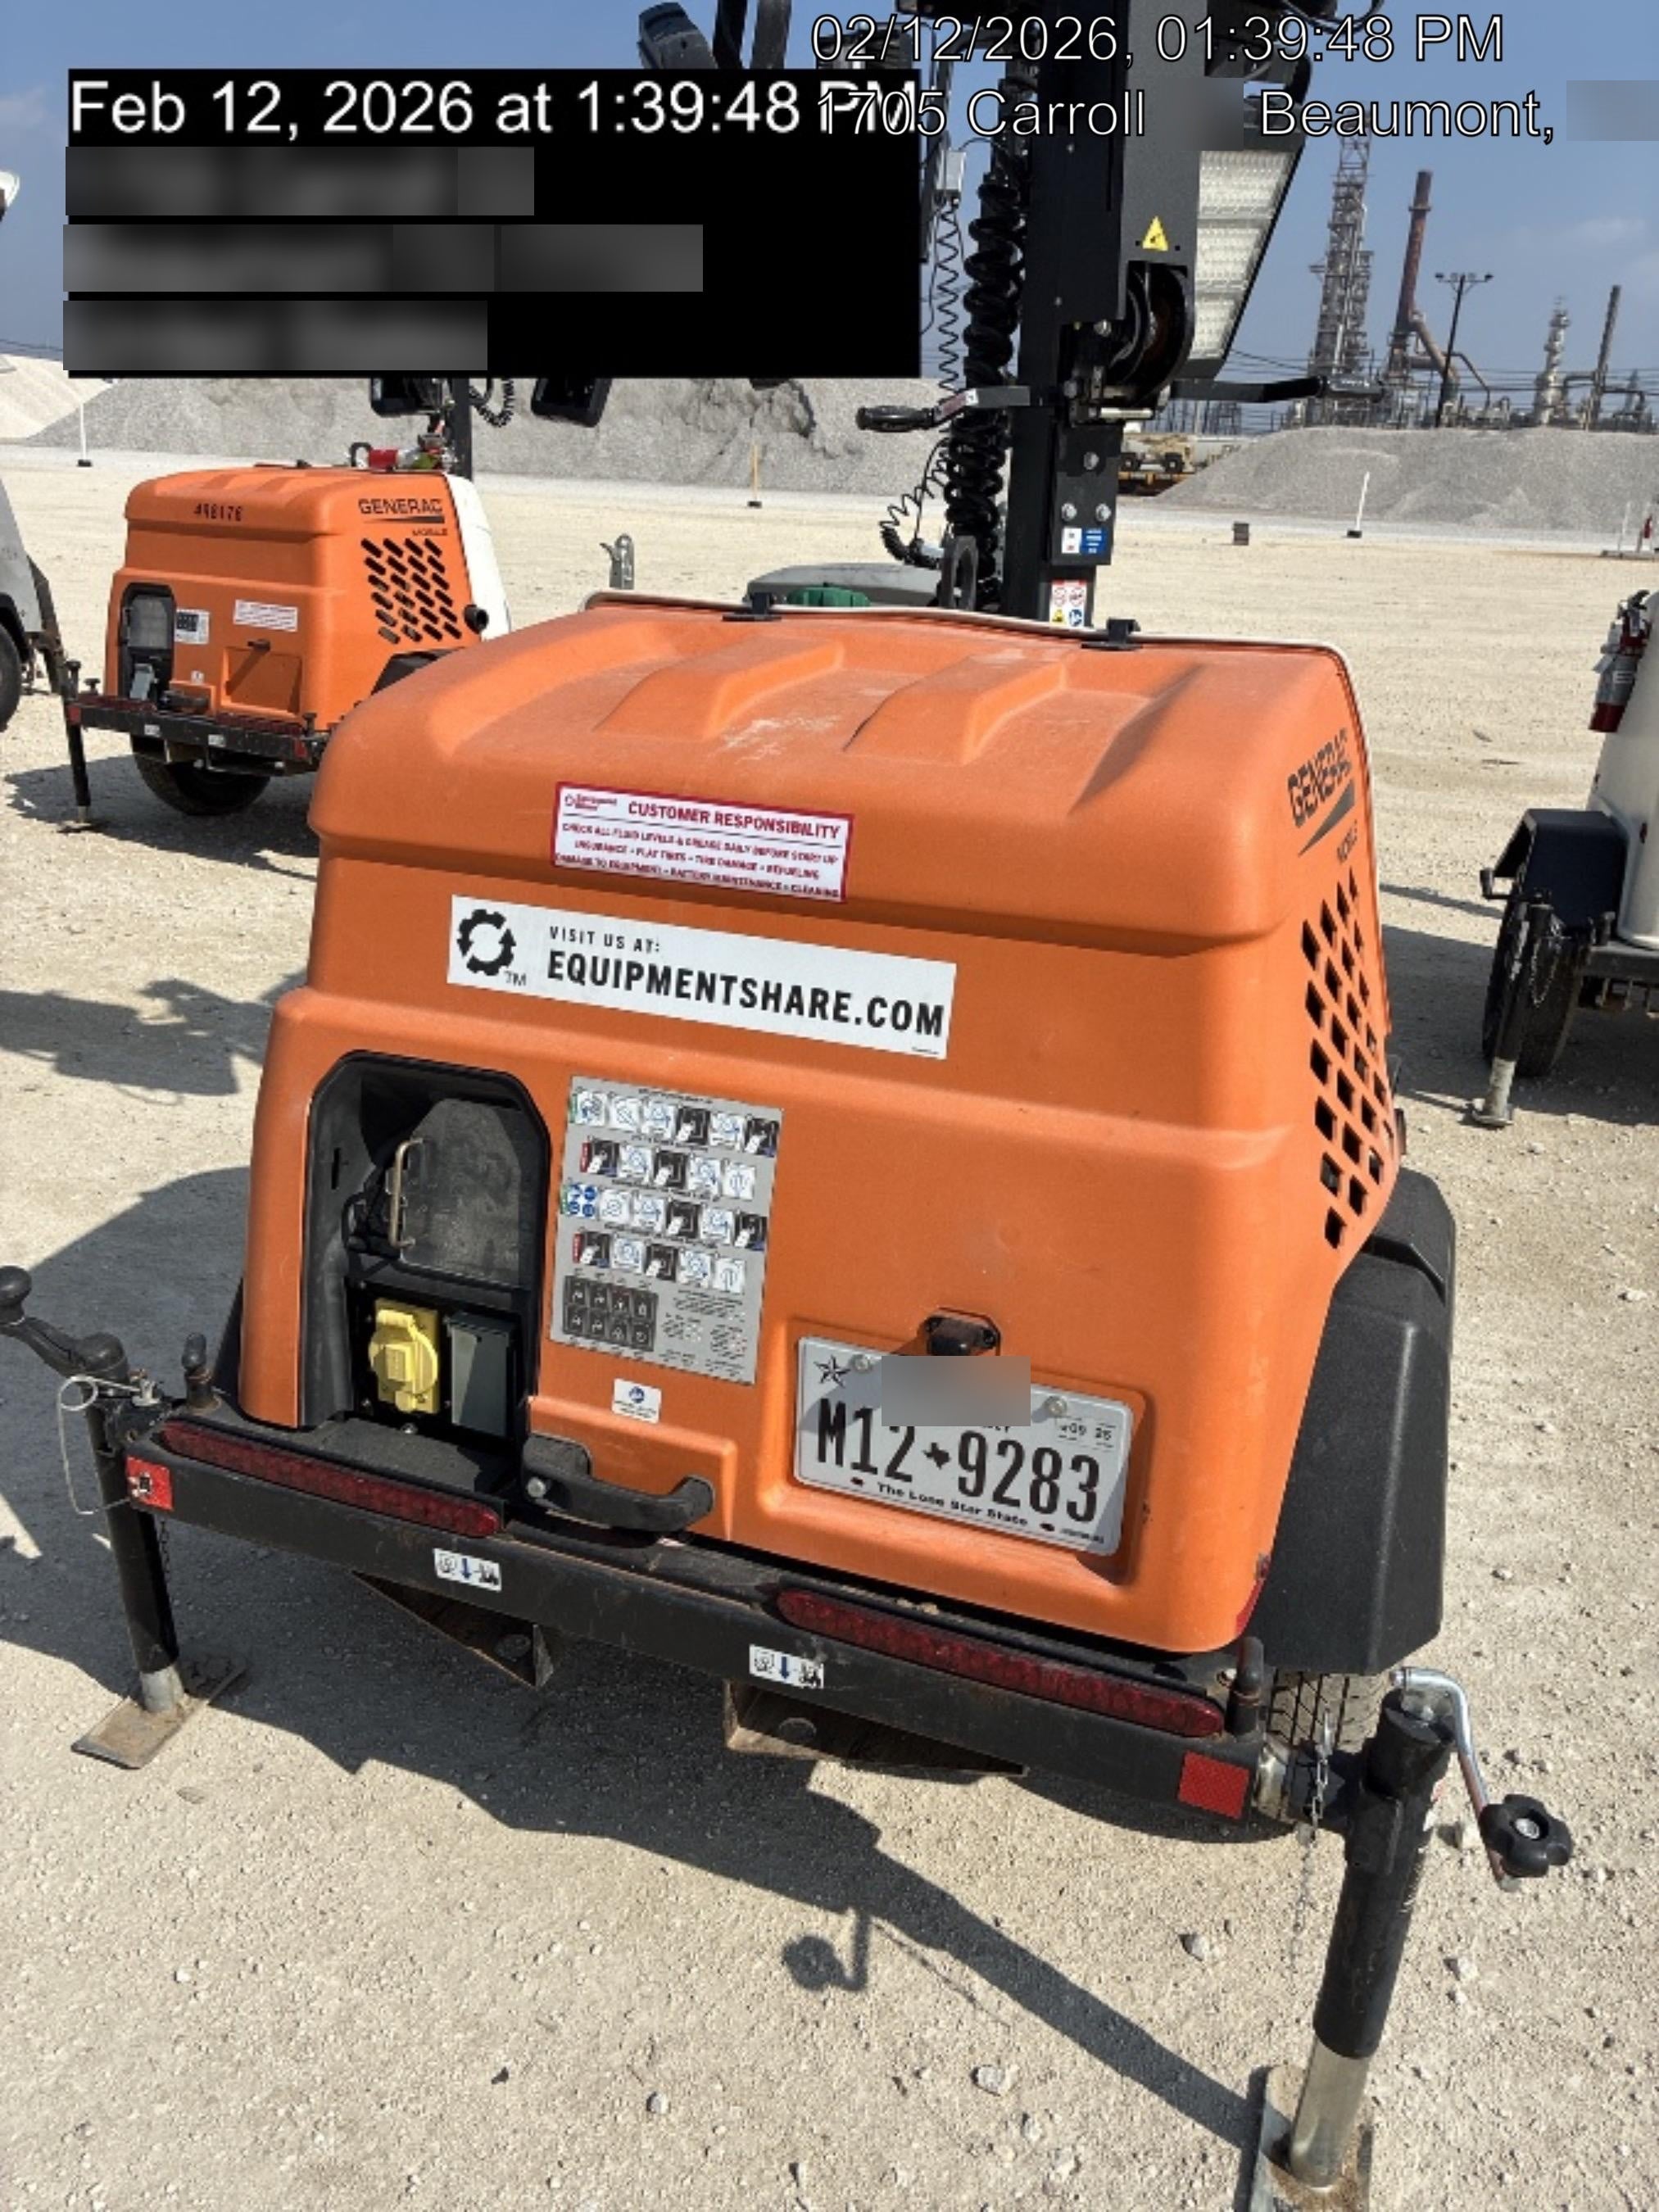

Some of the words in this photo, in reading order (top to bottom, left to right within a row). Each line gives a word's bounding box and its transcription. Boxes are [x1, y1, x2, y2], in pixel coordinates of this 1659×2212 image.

[358, 498, 443, 514] GENERAC
[1288, 728, 1352, 828] GENERAC
[628, 800, 710, 824] CUSTOMER
[714, 810, 841, 840] RESPONSIBILITY
[549, 925, 595, 945] VISIT
[603, 933, 626, 950] US
[633, 938, 662, 954] AT:
[505, 970, 527, 987] TM
[546, 950, 945, 1037] EQUIPMENTSHARE.COM
[877, 1481, 905, 1498] The
[909, 1489, 945, 1507] Lone
[950, 1500, 982, 1516] Star
[987, 1507, 1029, 1527] State
